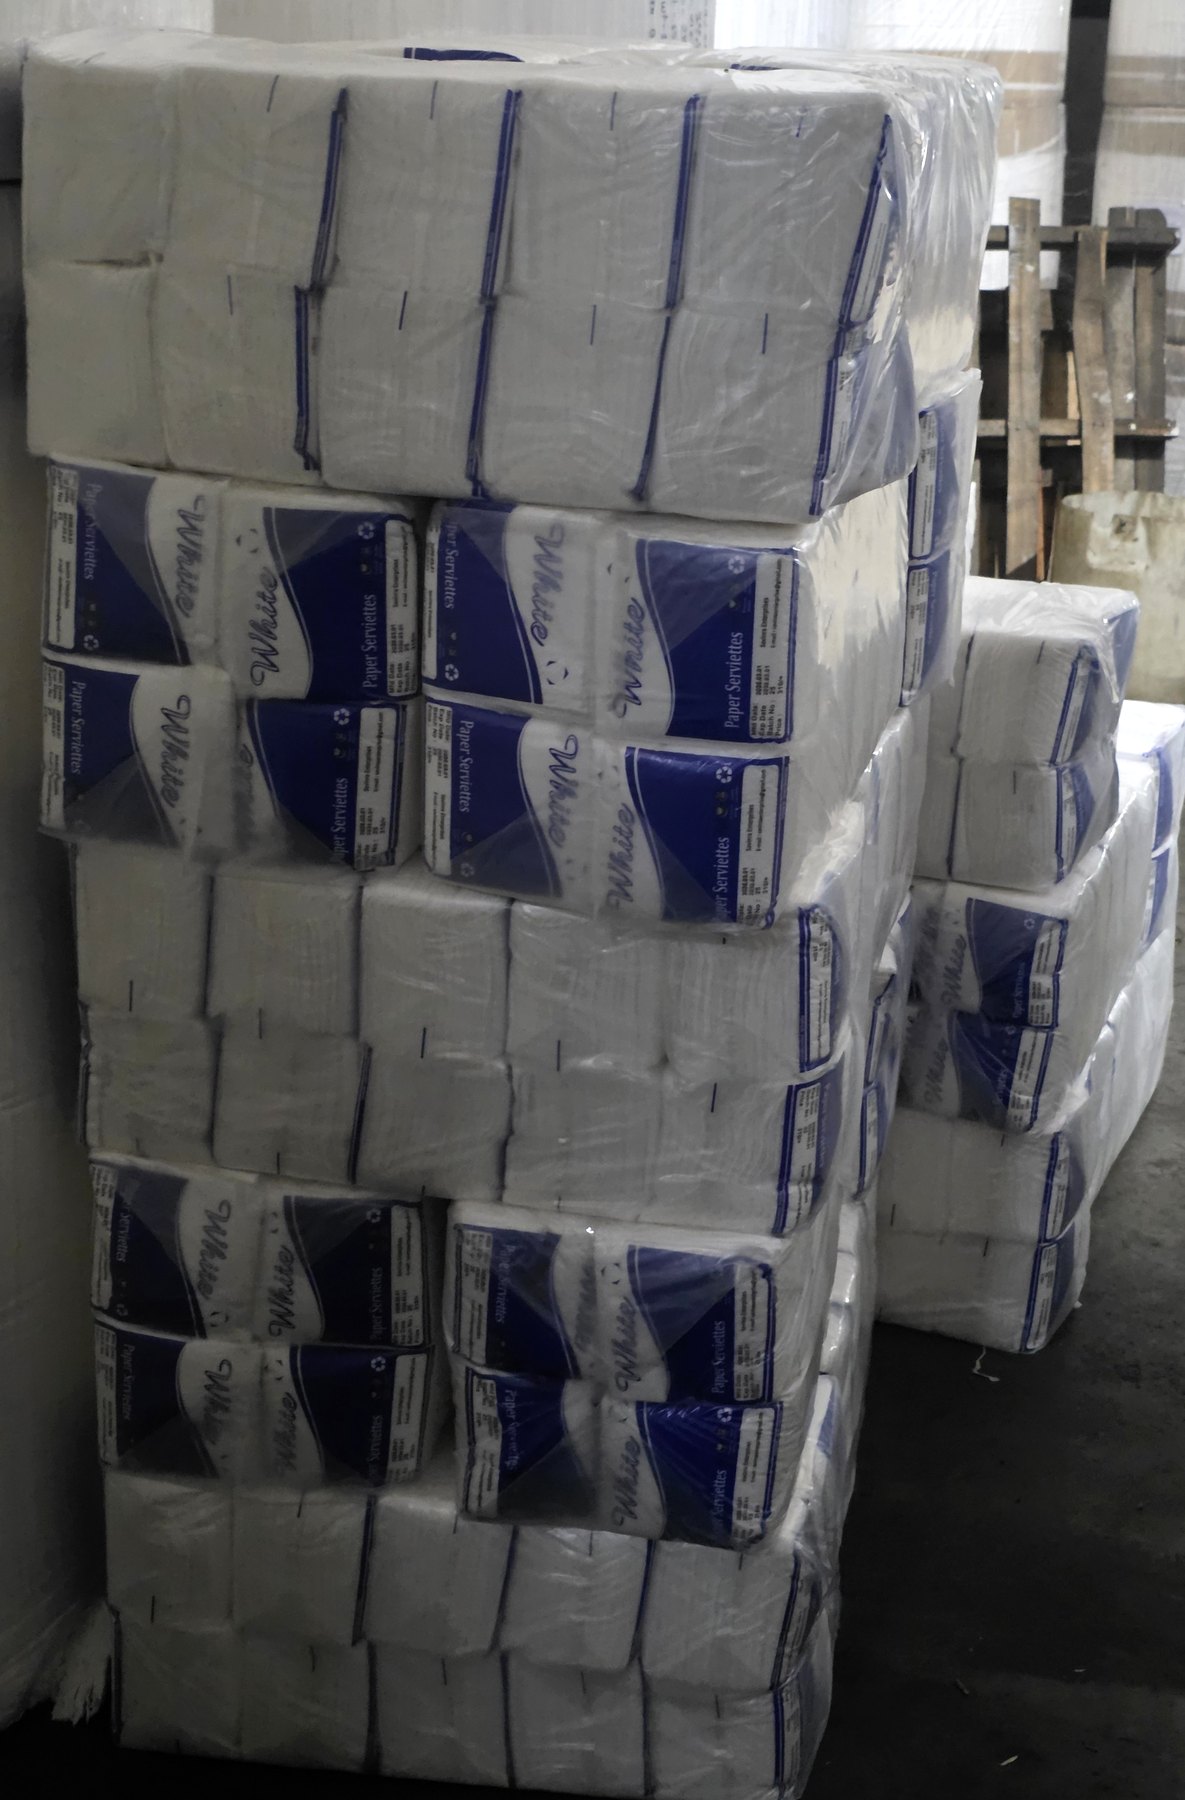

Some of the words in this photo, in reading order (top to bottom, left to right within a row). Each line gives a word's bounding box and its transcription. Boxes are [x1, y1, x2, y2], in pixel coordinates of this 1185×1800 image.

[83, 521, 100, 580] Serviettes
[174, 495, 204, 618] White
[444, 548, 459, 609] Serviettes
[531, 524, 565, 646] White
[249, 568, 279, 686] White
[361, 594, 377, 650] Serviettes
[363, 651, 381, 688] Paper
[613, 597, 645, 718] White
[724, 631, 743, 690] Serviettes
[69, 681, 86, 715] Paper
[724, 693, 742, 728] Paper
[768, 704, 775, 714] No
[70, 717, 84, 775] Serviettes
[160, 695, 191, 808] White
[456, 721, 473, 757] Paper
[331, 777, 349, 833] Serviettes
[458, 758, 473, 813] Serviettes
[549, 735, 579, 848] White
[607, 802, 636, 910] White
[713, 836, 730, 891] Serviettes
[199, 1200, 231, 1300] White
[267, 1245, 295, 1338] White
[370, 1266, 384, 1310] Serviettes
[611, 1296, 641, 1393] White
[711, 1320, 726, 1364] Serviettes
[711, 1366, 726, 1393] Paper
[367, 1415, 384, 1462] Serviettes
[610, 1435, 640, 1527] White
[711, 1469, 727, 1513] Serviettes
